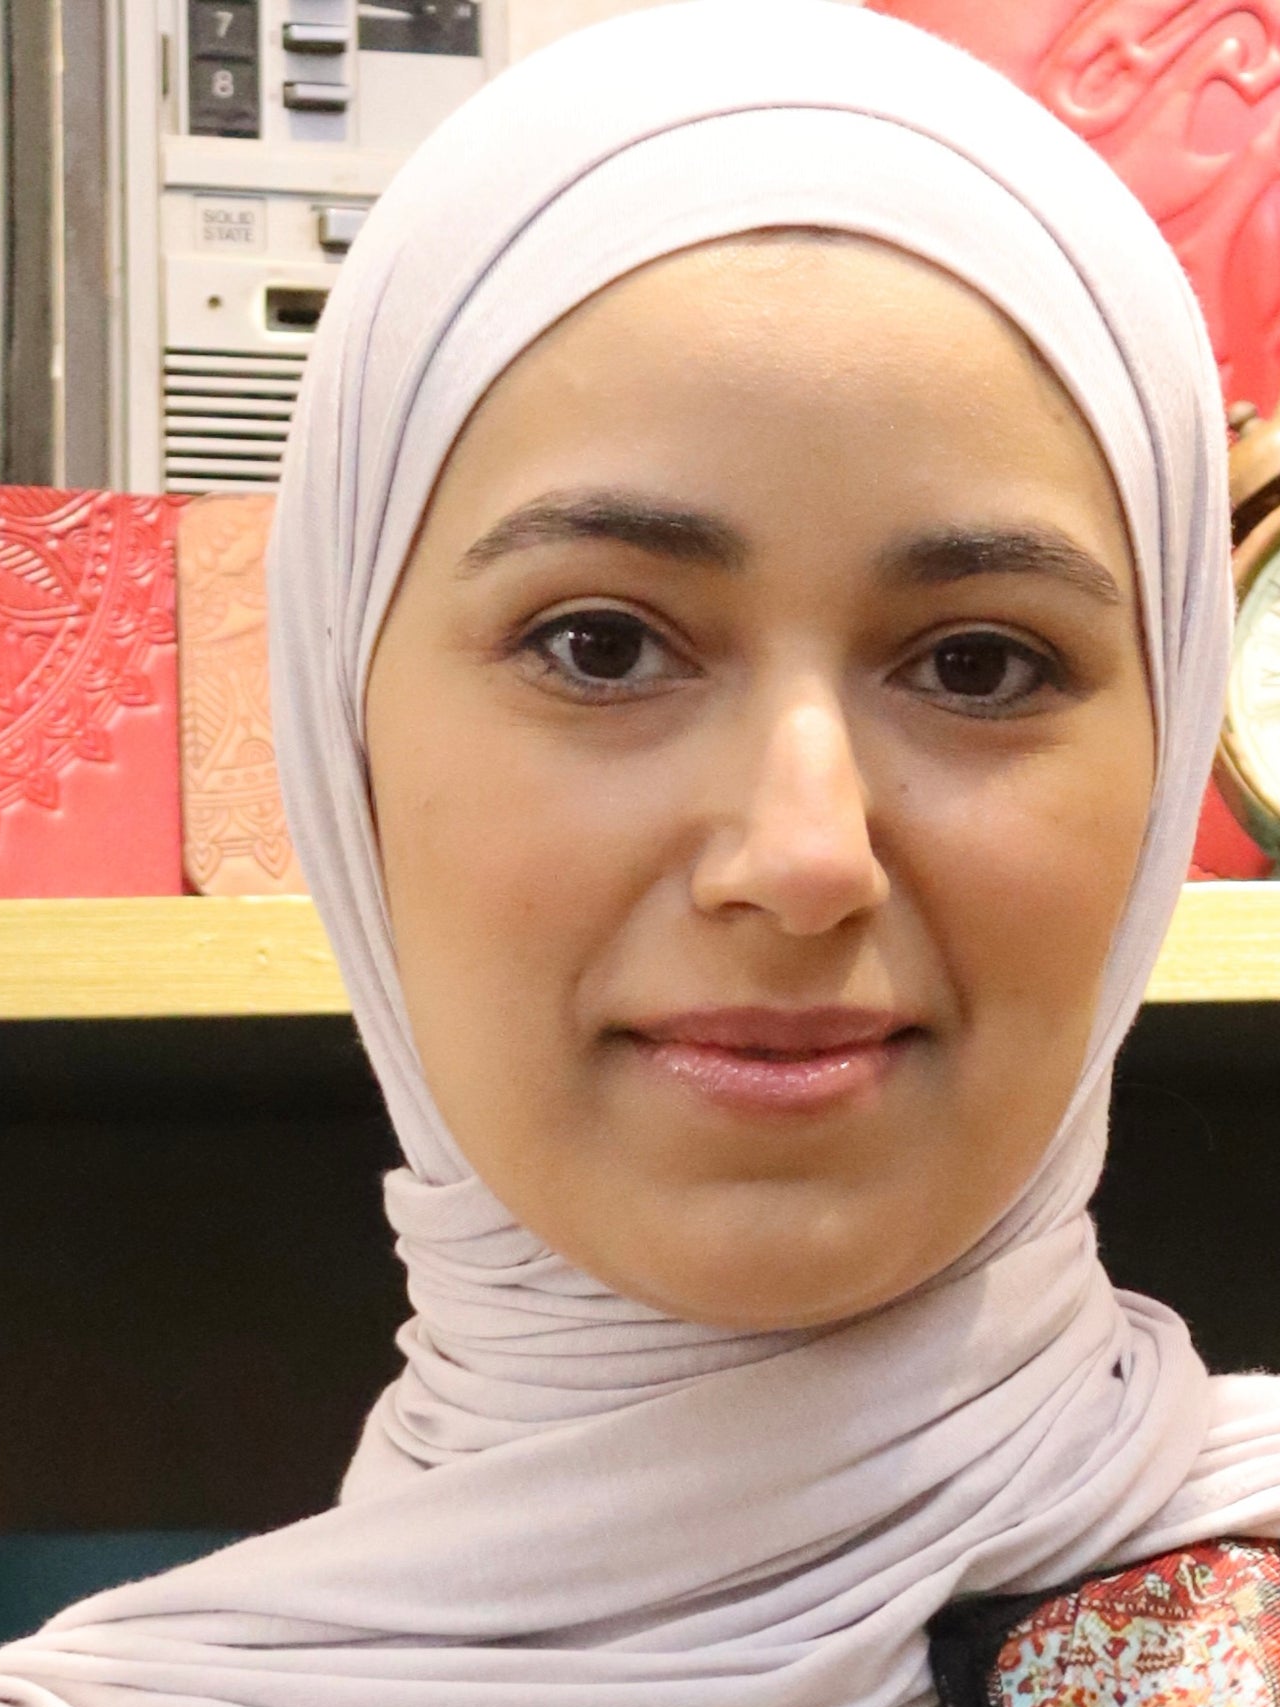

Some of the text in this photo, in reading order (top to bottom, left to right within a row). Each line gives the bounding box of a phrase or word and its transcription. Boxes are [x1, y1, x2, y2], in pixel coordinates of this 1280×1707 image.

[214, 10, 234, 39] 7
[211, 70, 235, 98] 8
[203, 208, 255, 224] SOLID
[203, 226, 255, 242] STATE
